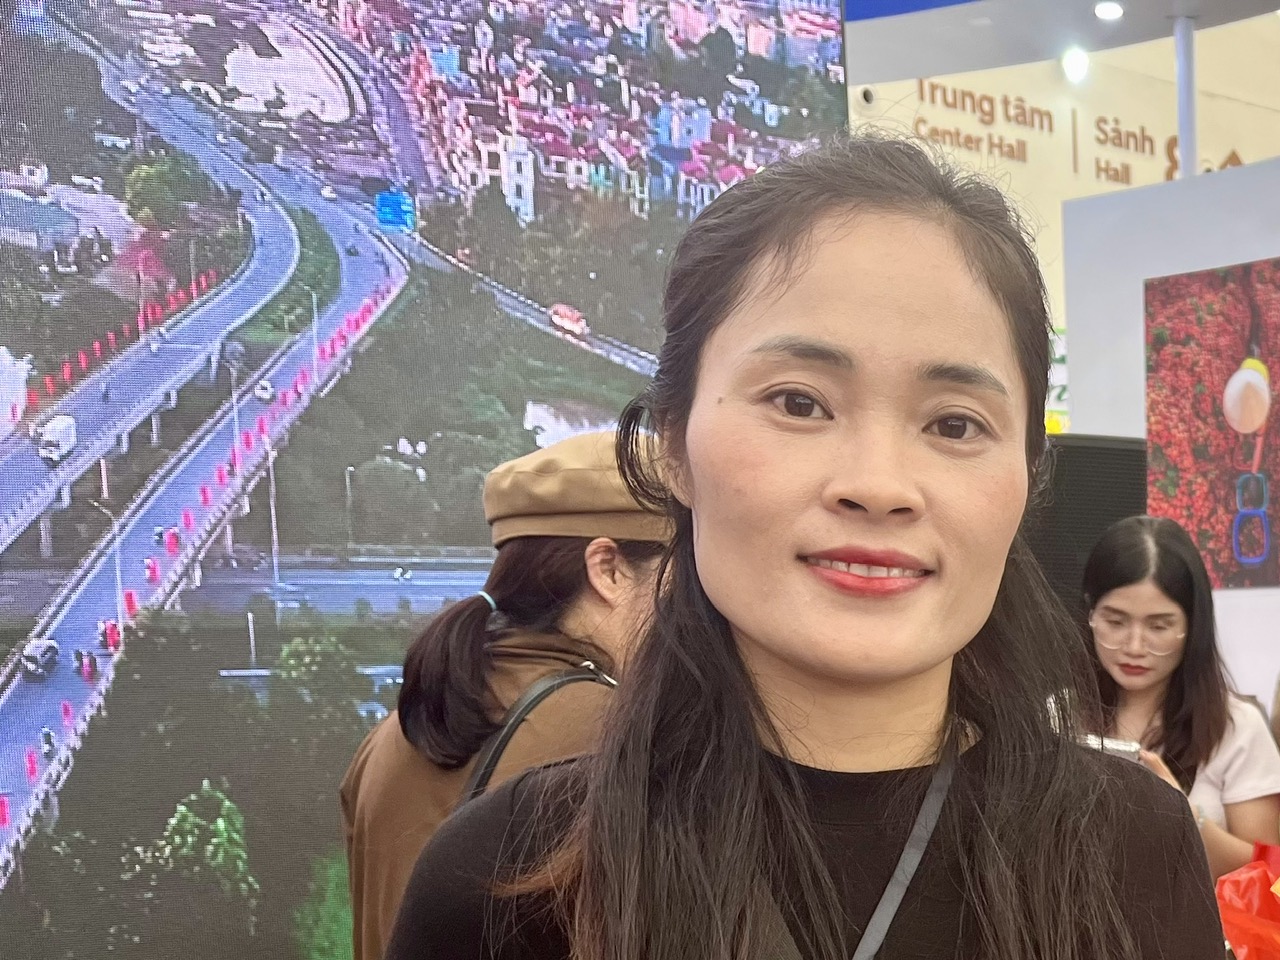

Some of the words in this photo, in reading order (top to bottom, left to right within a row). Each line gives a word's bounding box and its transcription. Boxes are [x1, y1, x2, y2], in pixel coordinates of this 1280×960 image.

[917, 78, 995, 126] Trung
[1002, 92, 1053, 133] tâm
[915, 120, 981, 151] Center
[988, 135, 1027, 163] Hall
[1094, 116, 1155, 156] Sảnh
[1094, 158, 1131, 185] Hall
